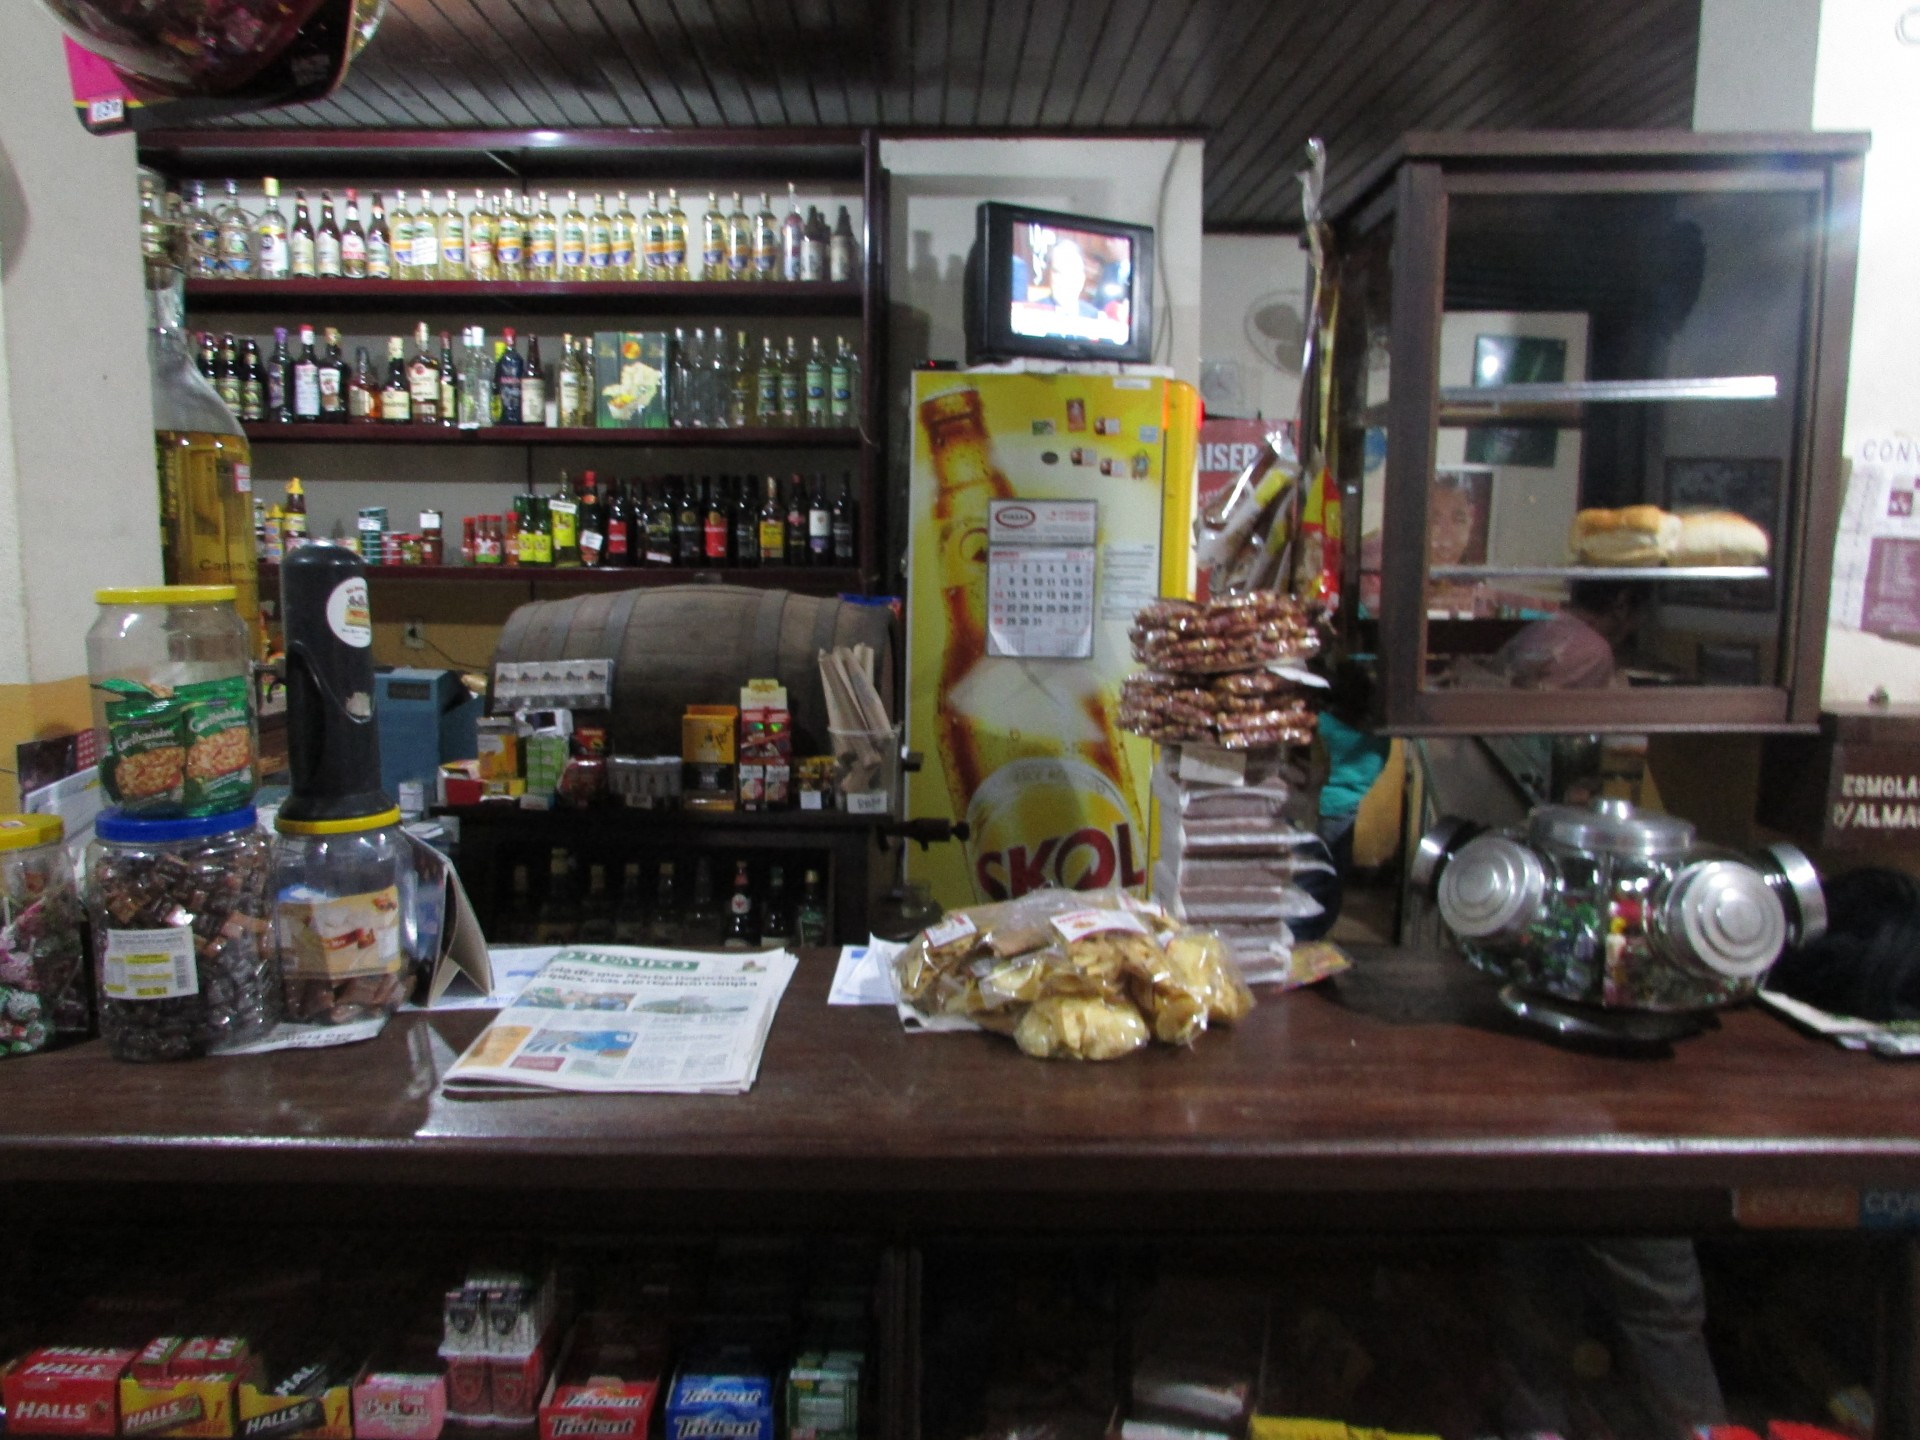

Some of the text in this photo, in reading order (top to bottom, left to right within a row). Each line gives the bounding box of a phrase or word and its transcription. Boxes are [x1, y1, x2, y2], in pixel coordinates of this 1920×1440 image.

[1842, 774, 1920, 797] ESMOLA
[976, 822, 1145, 900] SKOL
[14, 1400, 87, 1419] HALLS
[126, 1400, 179, 1430] HALLS
[245, 1405, 302, 1436] HALLS
[551, 1416, 635, 1436] Trident
[674, 1415, 762, 1438] Trident
